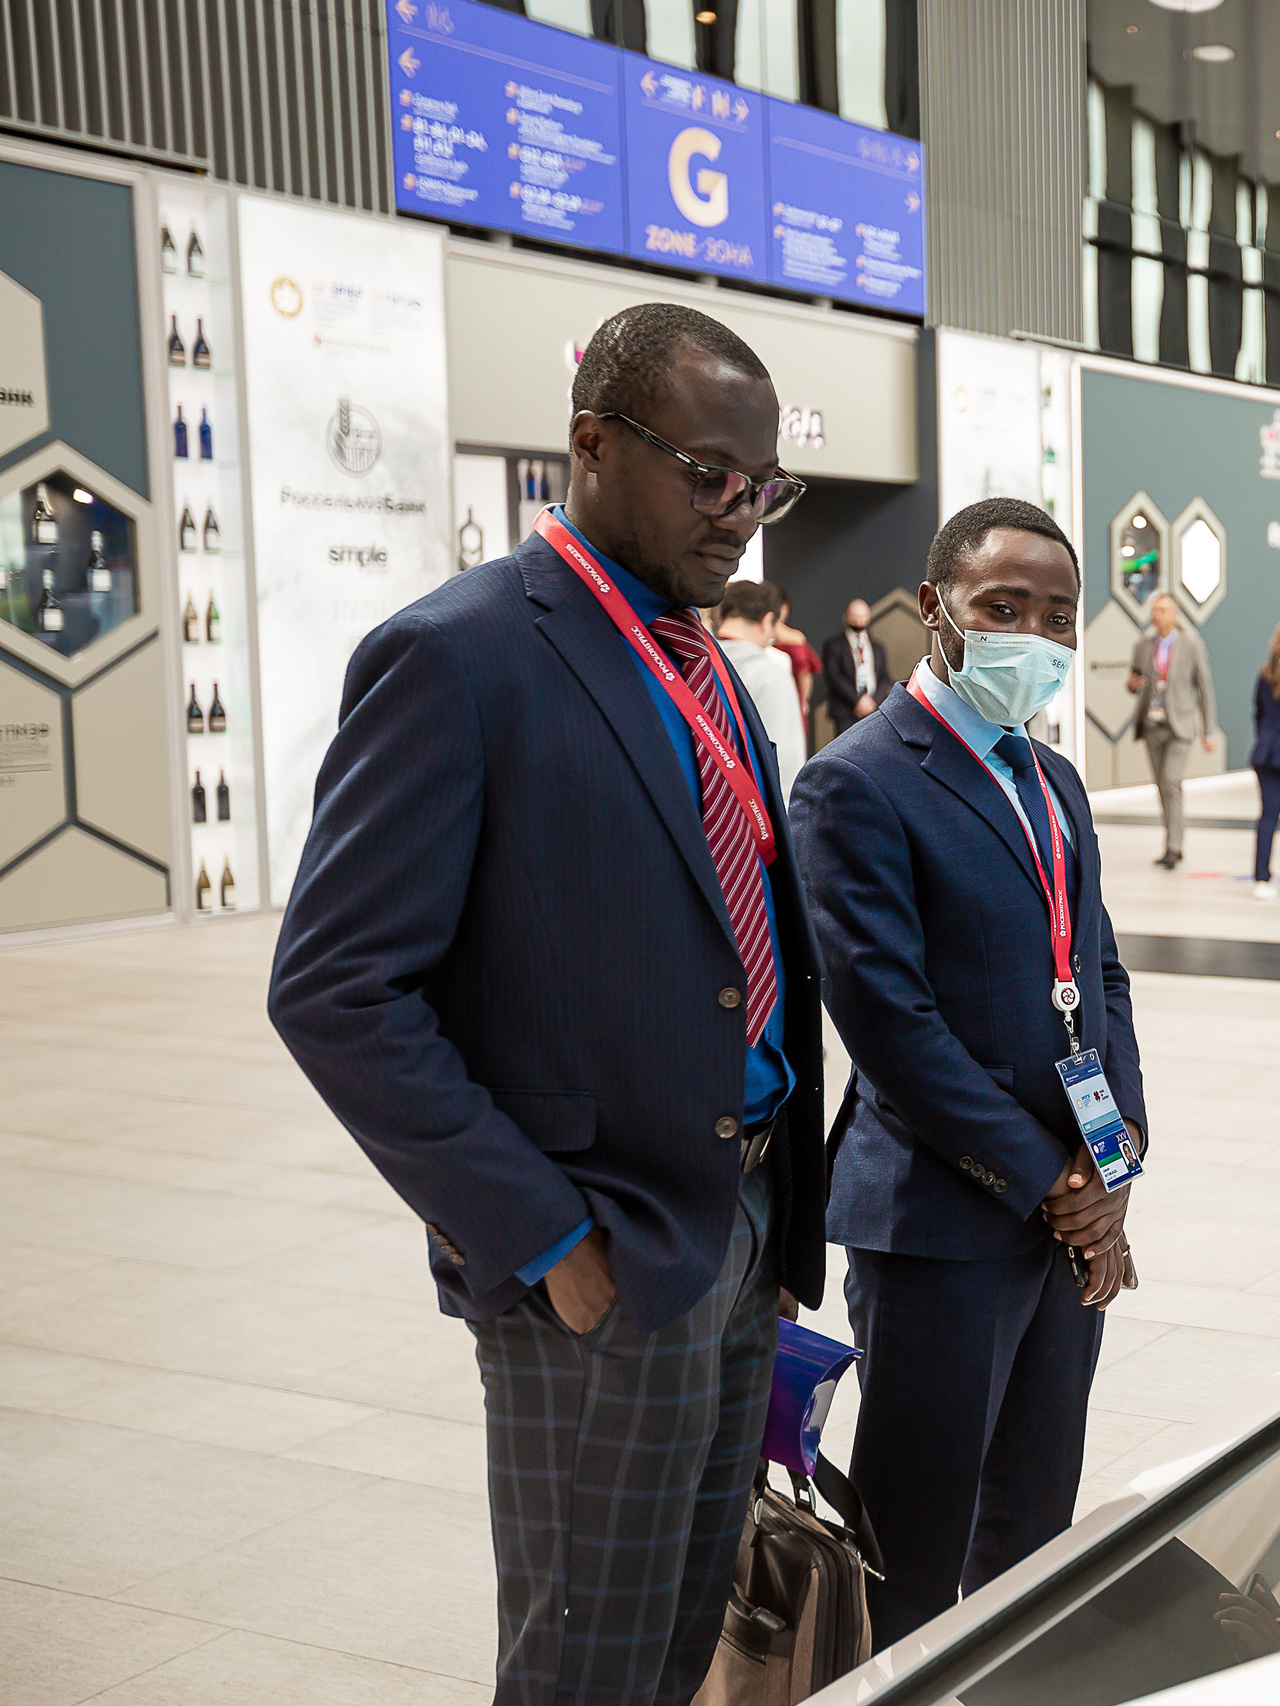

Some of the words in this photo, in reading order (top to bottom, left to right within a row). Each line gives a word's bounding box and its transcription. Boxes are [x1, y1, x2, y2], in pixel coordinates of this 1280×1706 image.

[669, 128, 728, 227] G
[645, 224, 697, 258] ZONE
[779, 405, 825, 451] ад
[328, 540, 389, 569] simple
[1116, 1132, 1127, 1142] XXV
